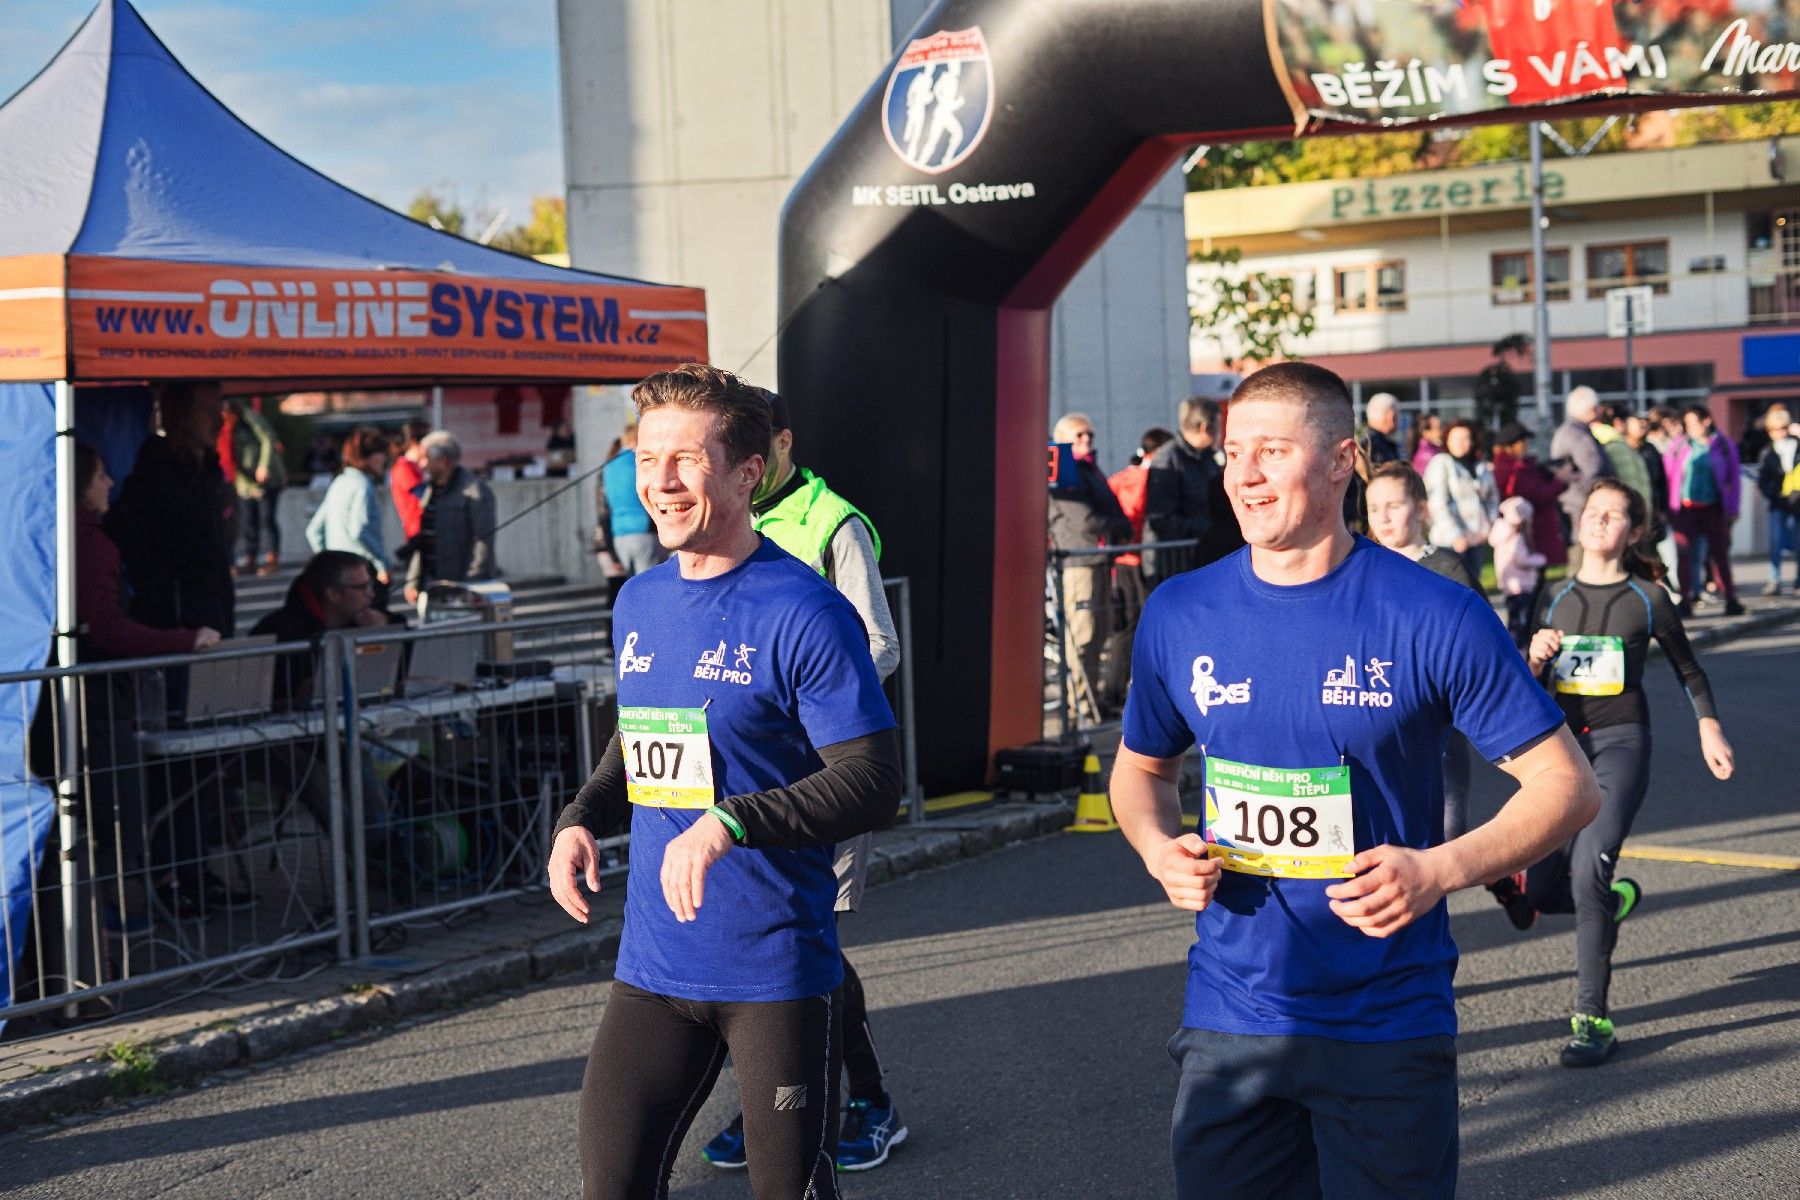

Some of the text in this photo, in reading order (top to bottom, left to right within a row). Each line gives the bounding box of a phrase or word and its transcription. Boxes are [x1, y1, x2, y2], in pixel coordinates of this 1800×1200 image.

[1310, 41, 1667, 108] BĚŽÍM S VÁMI
[852, 185, 882, 206] MK
[948, 182, 1036, 204] Ostrava
[1330, 162, 1566, 219] Pizzerie
[693, 664, 752, 685] BĚH PRO
[1322, 687, 1393, 707] BĚH PRO
[632, 740, 685, 780] 107
[1215, 761, 1260, 781] BENEFIČNÍ
[1262, 768, 1284, 783] BĚH
[1286, 772, 1311, 784] PRO
[1292, 781, 1330, 797] ŠTĚPU
[1234, 800, 1320, 848] 108
